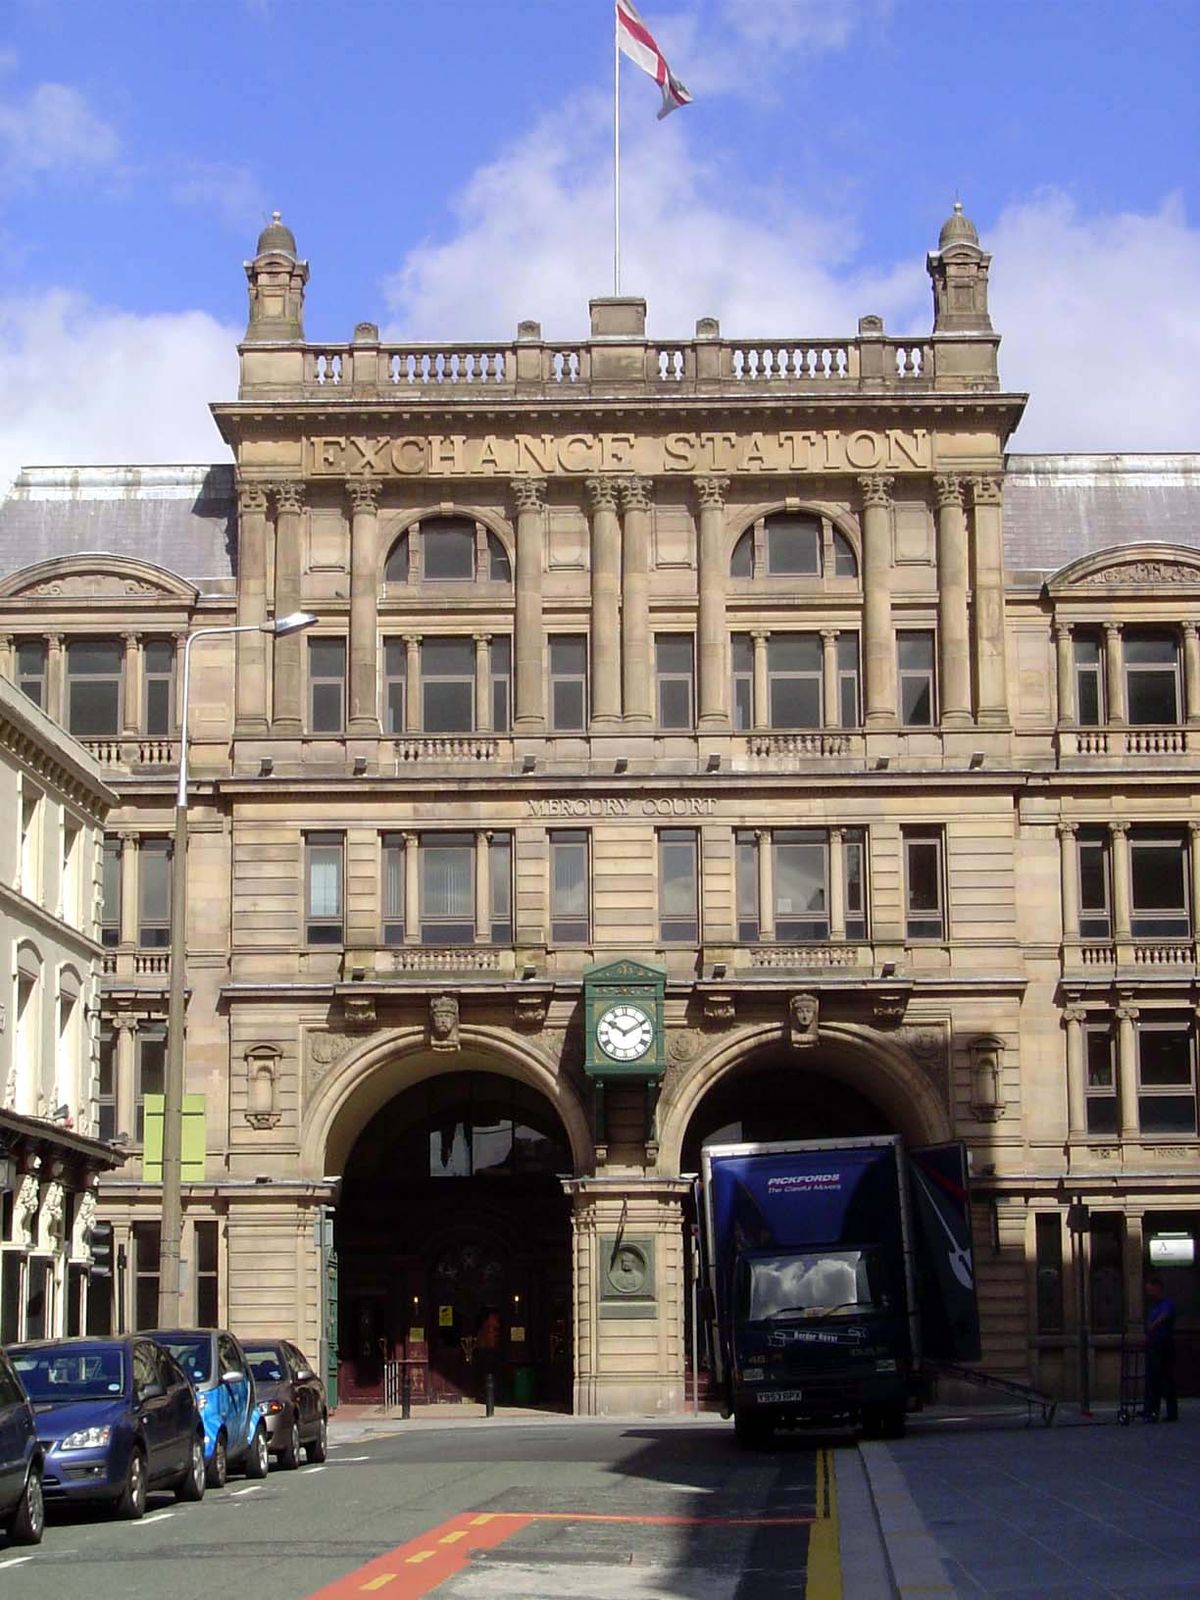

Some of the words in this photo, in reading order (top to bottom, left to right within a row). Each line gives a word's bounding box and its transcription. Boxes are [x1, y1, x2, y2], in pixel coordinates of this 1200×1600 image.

[310, 433, 635, 476] EXCHANGE
[664, 429, 927, 471] STATION
[528, 798, 630, 816] MERCURY
[642, 797, 717, 815] COURT
[768, 1173, 840, 1185] PICKFORDS
